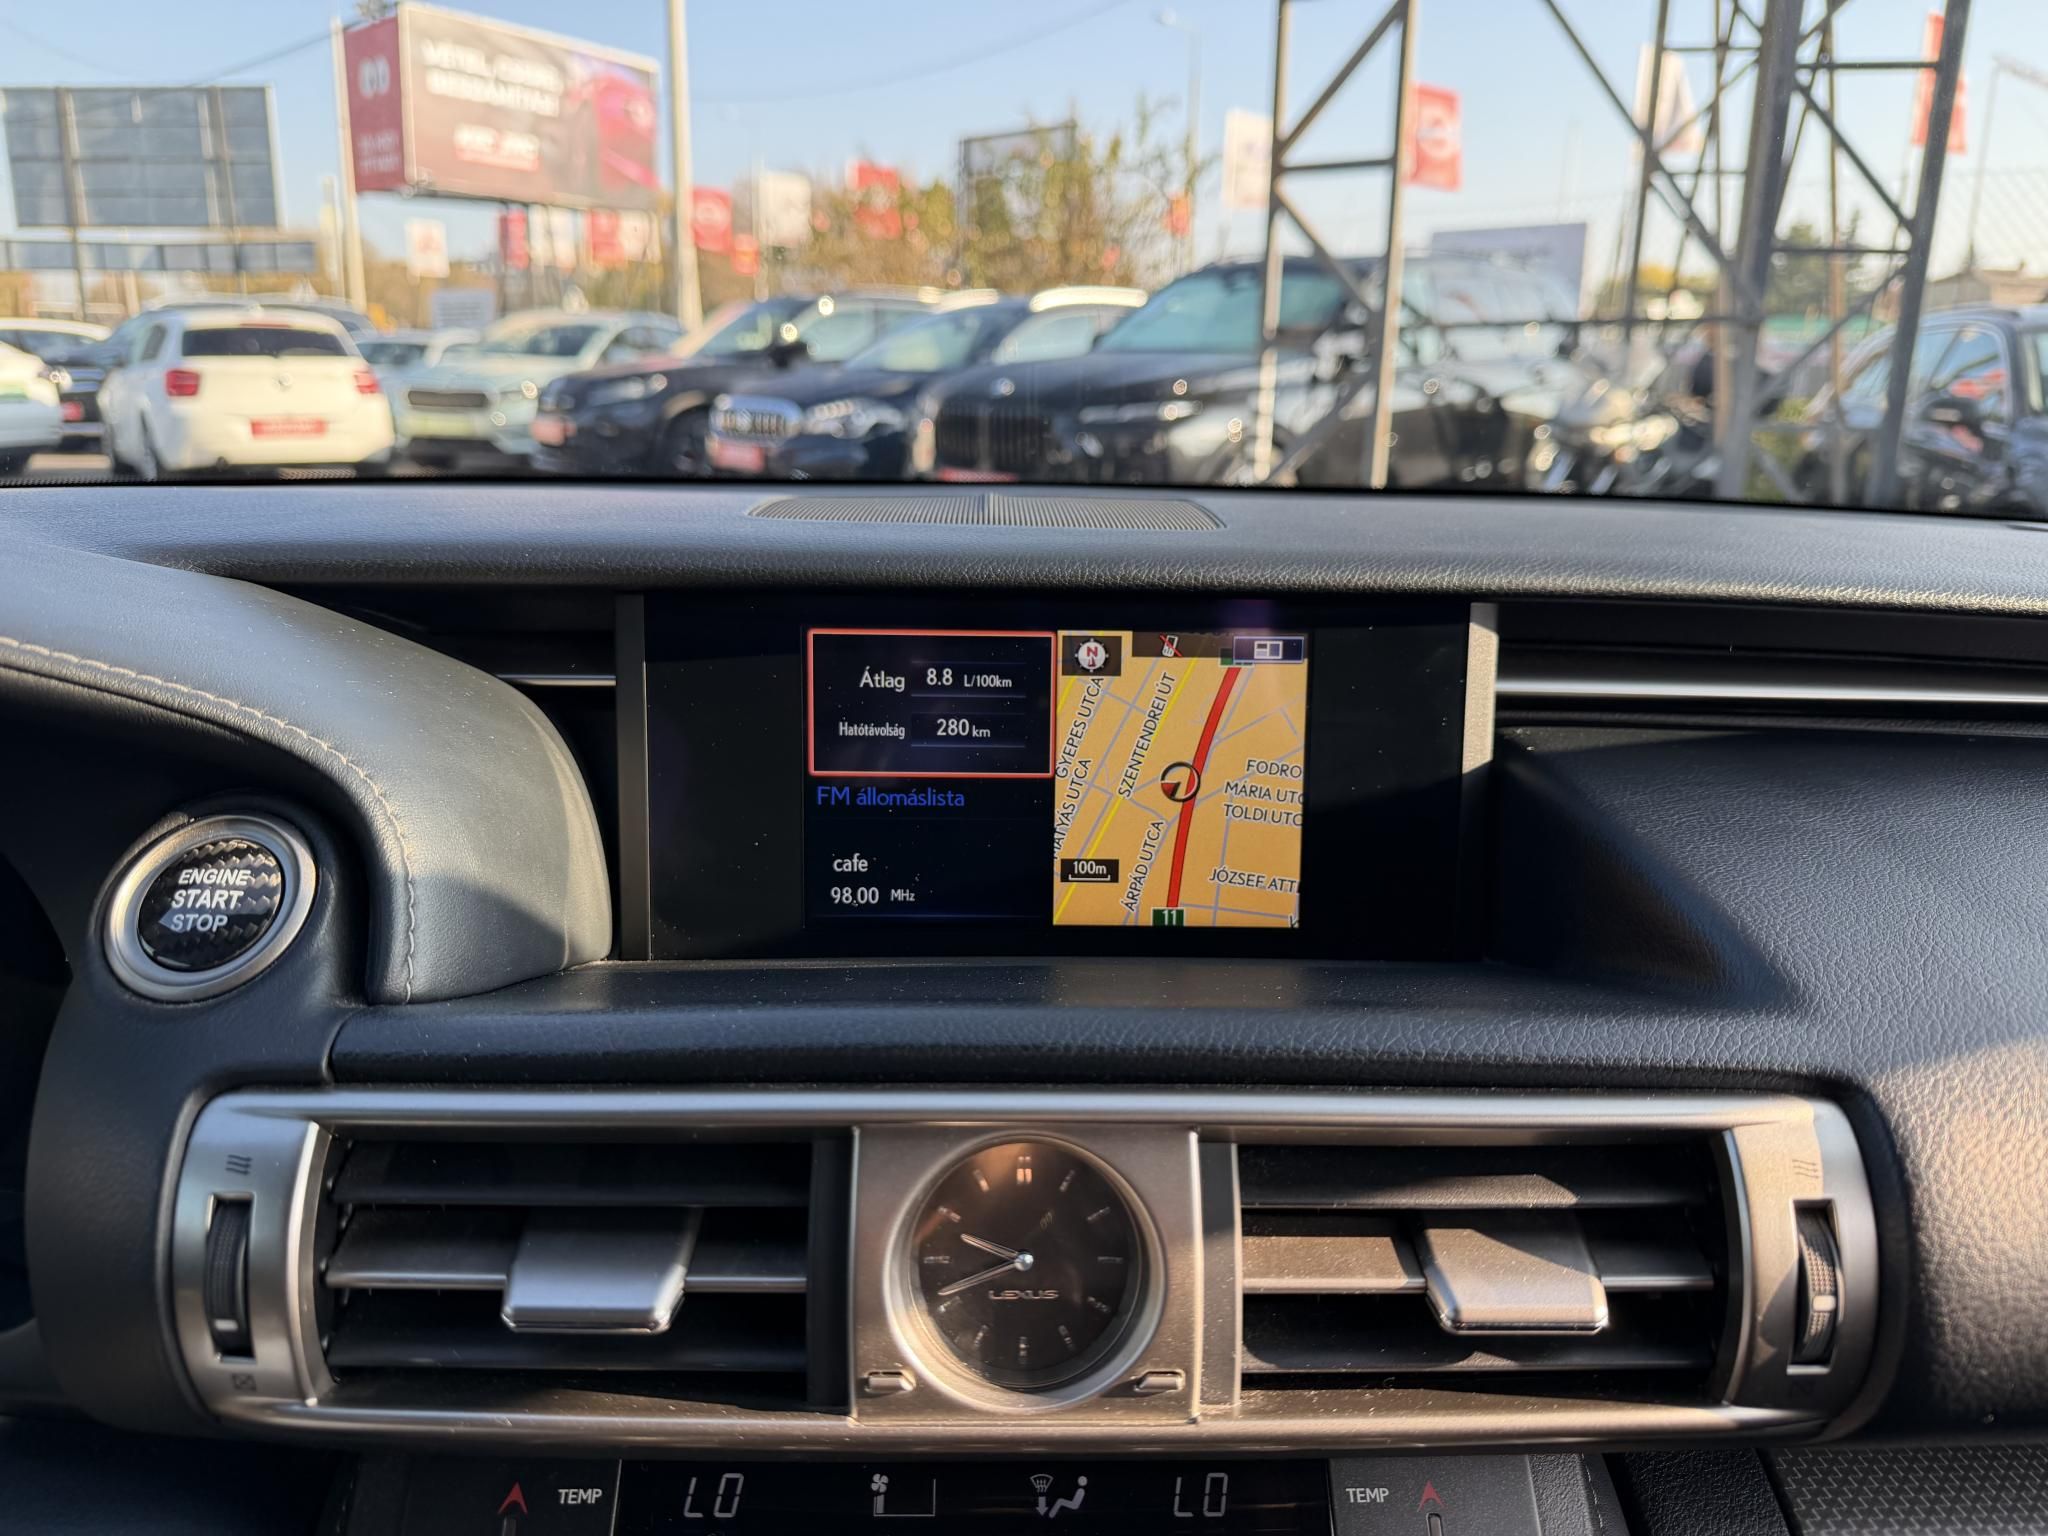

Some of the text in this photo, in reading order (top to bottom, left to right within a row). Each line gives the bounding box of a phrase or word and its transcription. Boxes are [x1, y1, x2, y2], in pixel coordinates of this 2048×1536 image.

[1086, 645, 1098, 657] N
[859, 666, 1013, 693] Átlag 8.8 L/100km
[838, 718, 991, 740] Hatótávolság 280 km
[1055, 677, 1105, 778] GYEPES UTCA
[1117, 671, 1176, 798] SZENTENDREI ÚT
[1066, 758, 1092, 800] UTCA
[817, 786, 965, 807] FM állomáslista
[1224, 781, 1272, 800] MÁRIA
[1223, 803, 1268, 822] TOLDI
[833, 853, 869, 872] cafe
[1073, 861, 1107, 874] 100m
[1120, 820, 1165, 912] ÁRPÁD UTCA
[178, 868, 251, 886] ENGINE
[1209, 866, 1266, 888] JÓZSEF
[171, 889, 244, 909] START
[830, 886, 915, 904] 98.00 MHz
[170, 914, 228, 932] STOP
[1162, 910, 1177, 925] 11
[988, 1289, 1059, 1300] LEXUS
[558, 1487, 602, 1505] TEMP
[1345, 1487, 1389, 1504] TEMP
